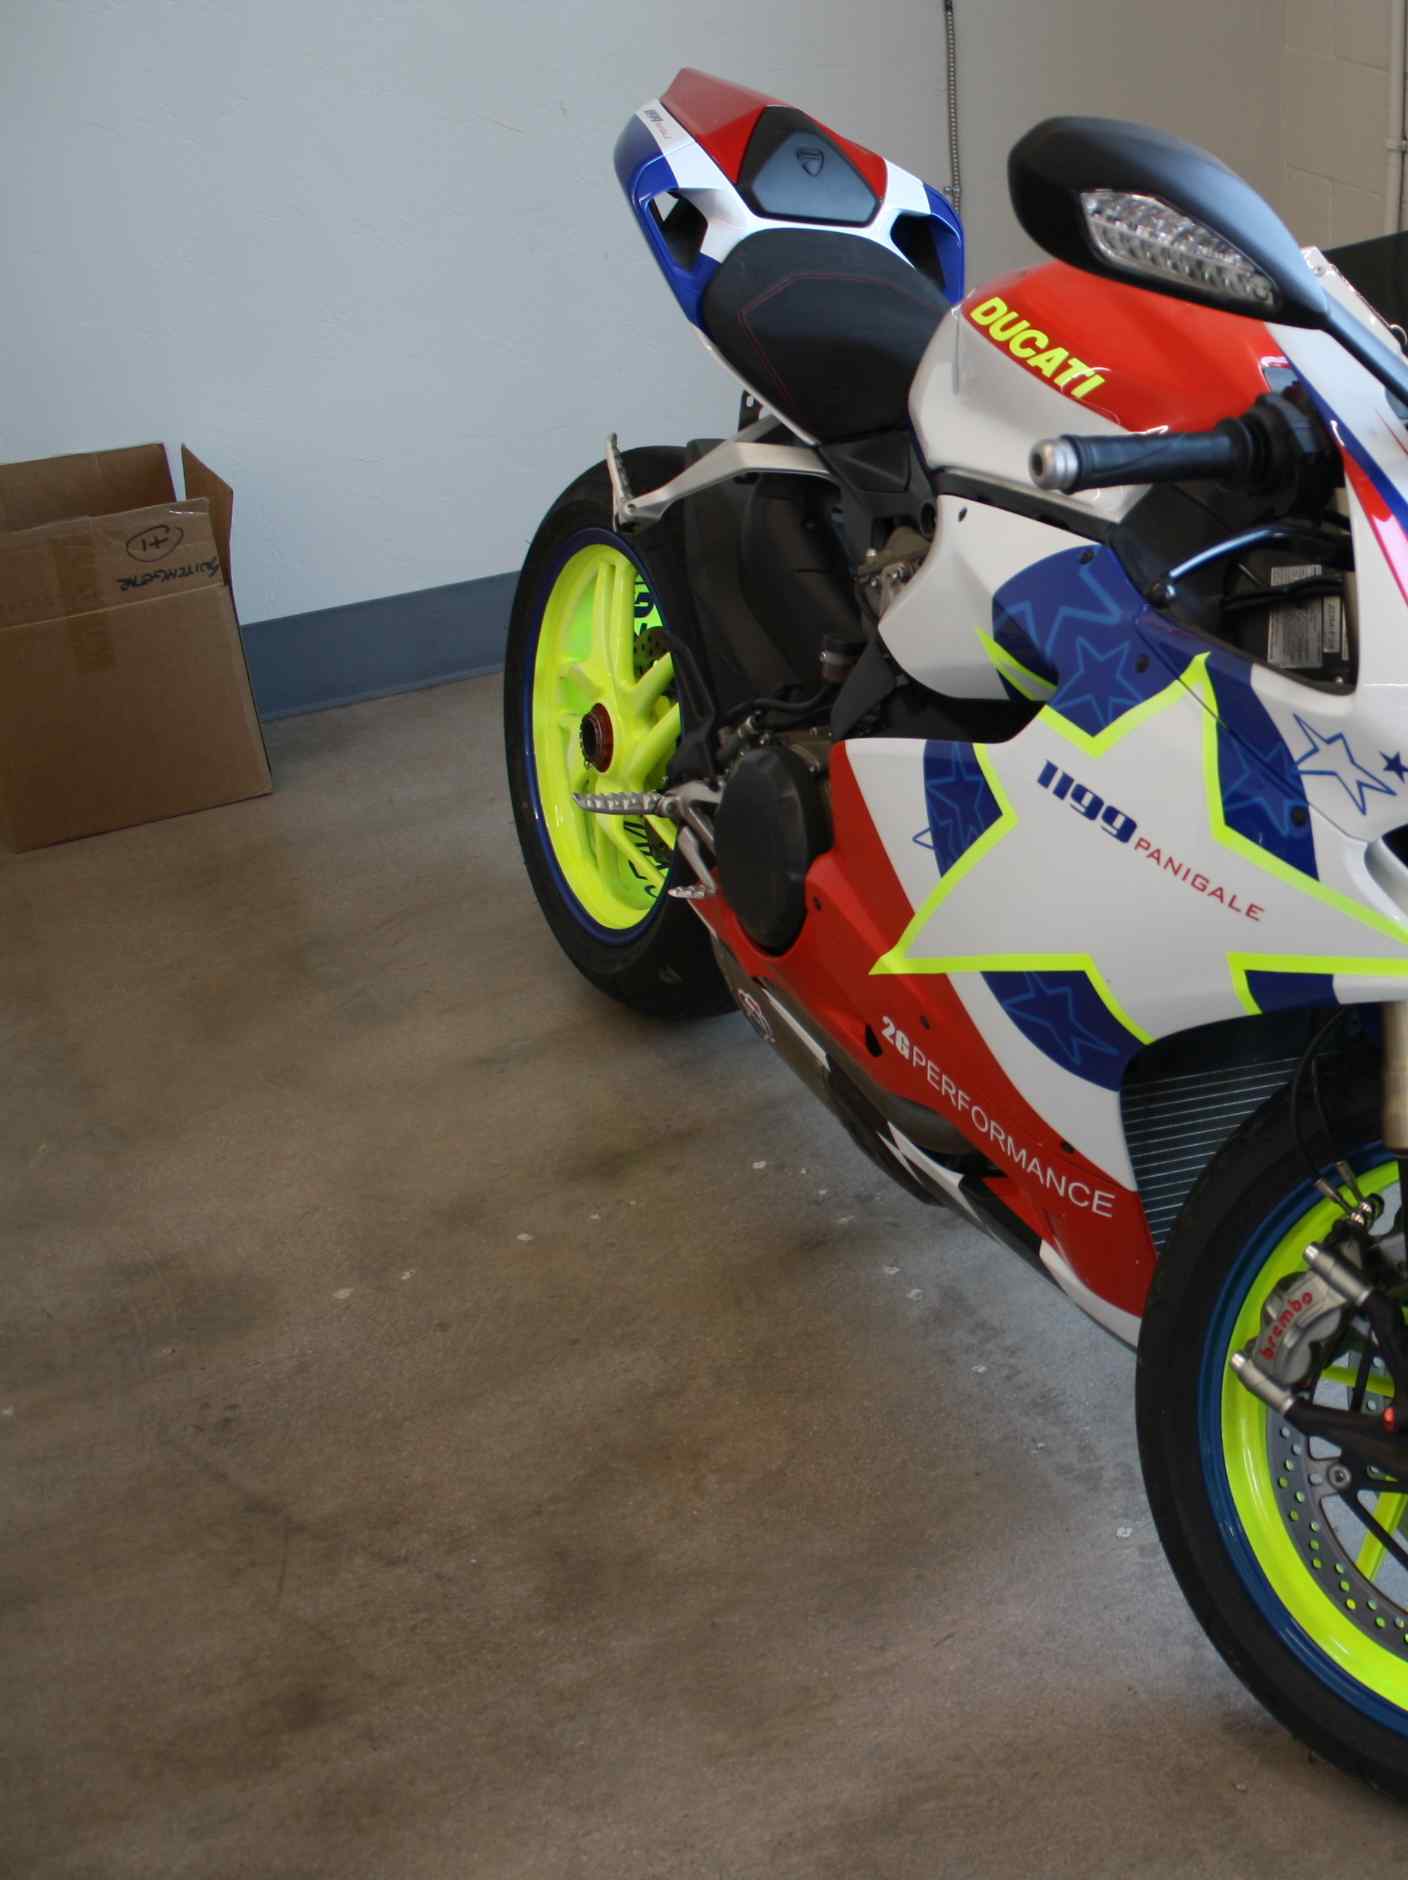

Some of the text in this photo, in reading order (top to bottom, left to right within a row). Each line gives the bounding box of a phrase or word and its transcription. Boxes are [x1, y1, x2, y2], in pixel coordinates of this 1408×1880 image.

[970, 296, 1105, 400] DUCATI
[1036, 759, 1265, 922] 1199 PANIGALE
[912, 1045, 1117, 1219] PERFORMANCE
[1257, 1290, 1313, 1361] brembo
